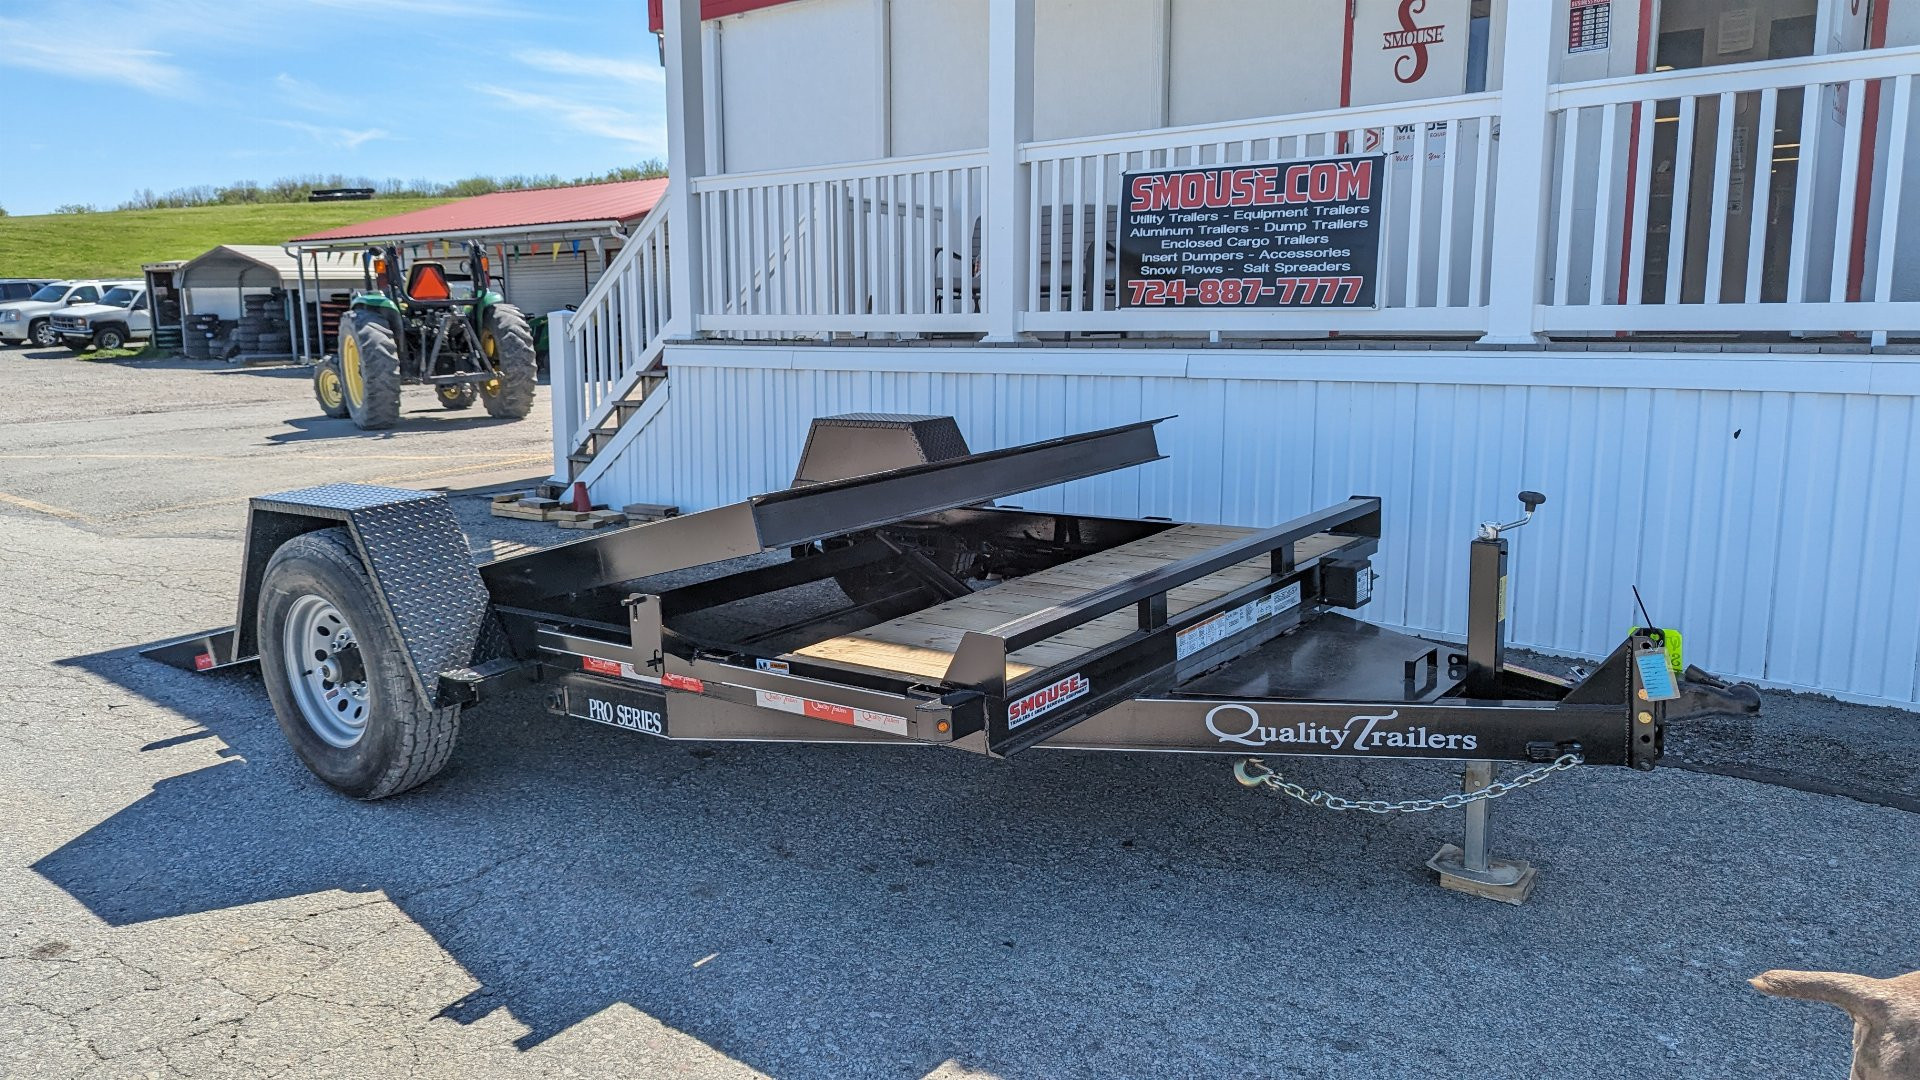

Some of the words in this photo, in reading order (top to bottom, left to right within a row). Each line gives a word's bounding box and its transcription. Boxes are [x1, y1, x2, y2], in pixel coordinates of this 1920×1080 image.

[1383, 27, 1444, 48] SMOUSE
[1130, 160, 1373, 212] SMOUSE.COM
[1130, 214, 1166, 226] Utility
[1168, 212, 1219, 223] Trailers
[1233, 207, 1309, 221] Equipment
[1313, 205, 1370, 216] Trailers
[1129, 227, 1194, 238] Aluminum
[1197, 224, 1250, 235] Trailers
[1264, 222, 1308, 233] Dump
[1311, 219, 1369, 230] Trailers
[1161, 238, 1222, 249] Enclosed
[1226, 237, 1270, 248] Cargo
[1274, 235, 1329, 246] Trailers
[1141, 253, 1178, 263] Insert
[1182, 252, 1244, 263] Dumpers
[1259, 248, 1351, 260] Accessories
[1140, 265, 1178, 275] Snow
[1181, 264, 1224, 275] Plows
[1243, 263, 1270, 273] Salt
[1274, 262, 1351, 274] Spreaders
[1127, 276, 1364, 305] 724-887-7777
[588, 699, 614, 723] PRO
[616, 704, 662, 734] SERIES
[1205, 703, 1349, 750] Quality
[1344, 709, 1478, 751] Trailers
